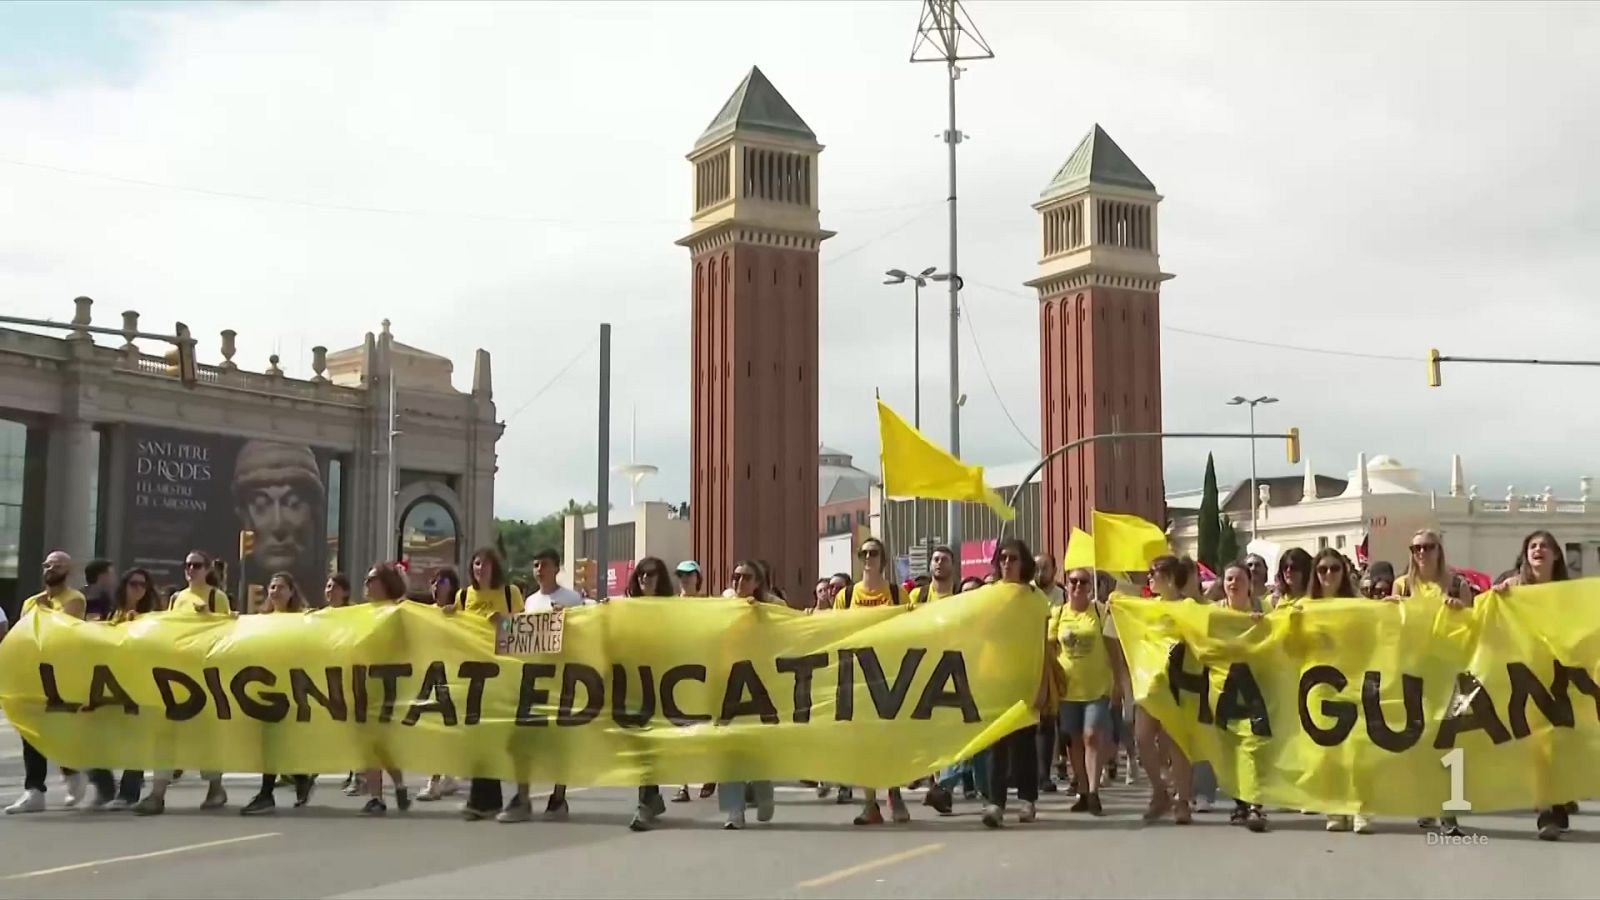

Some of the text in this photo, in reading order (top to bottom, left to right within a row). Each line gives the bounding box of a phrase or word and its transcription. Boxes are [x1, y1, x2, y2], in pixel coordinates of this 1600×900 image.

[507, 634, 561, 653] PANTALLES
[509, 612, 562, 634] MESTRES
[39, 646, 982, 729] LA DIGNITAT EDUCATIVA
[1168, 638, 1273, 738] HA
